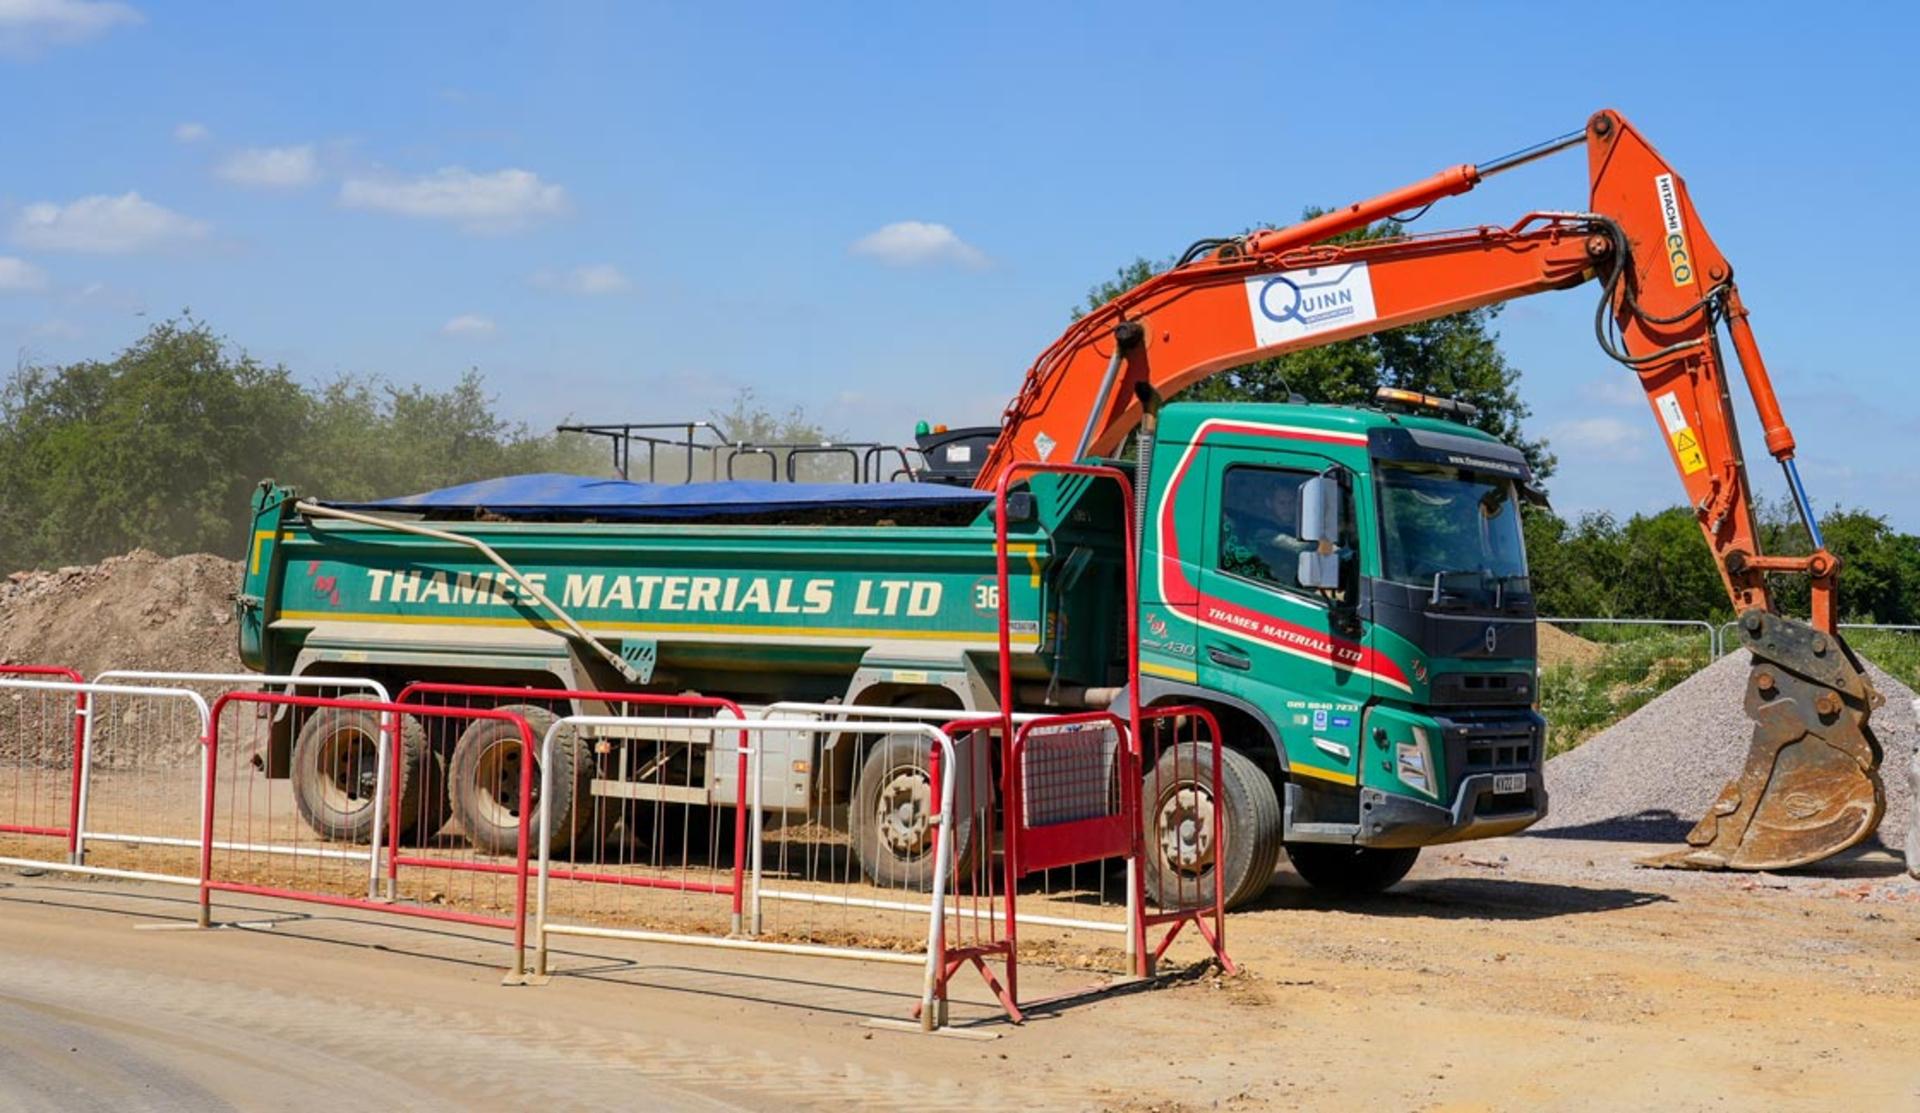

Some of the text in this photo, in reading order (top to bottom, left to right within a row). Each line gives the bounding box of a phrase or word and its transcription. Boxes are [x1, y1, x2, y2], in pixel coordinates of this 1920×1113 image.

[1660, 178, 1678, 230] HITACHI
[1259, 276, 1353, 324] QUINN
[367, 569, 943, 616] THAMES MATERIALS LTD
[975, 586, 999, 609] 36
[1208, 608, 1363, 662] THAMES MATERIALS LTD
